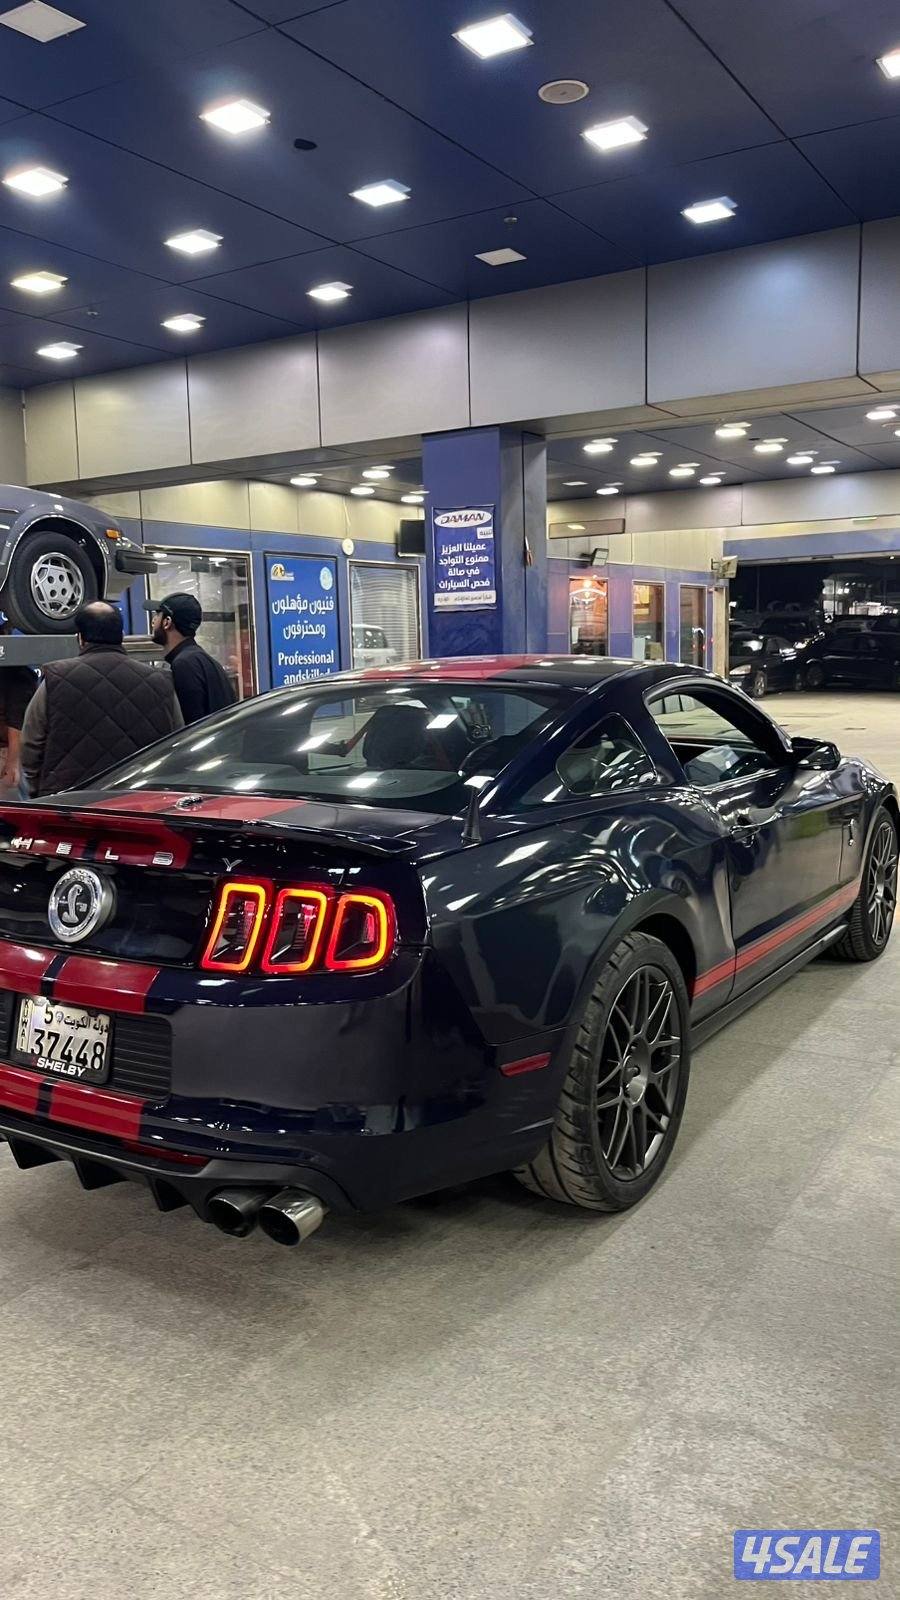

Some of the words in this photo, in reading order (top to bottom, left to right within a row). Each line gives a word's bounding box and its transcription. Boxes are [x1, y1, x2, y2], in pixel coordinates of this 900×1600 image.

[440, 513, 485, 524] DAMAN
[441, 543, 462, 555] العزيز
[463, 542, 486, 552] عميلنا
[439, 555, 464, 566] التواجد
[465, 555, 489, 565] ممنوع
[448, 567, 465, 576] صالة
[466, 567, 480, 577] في
[438, 578, 470, 590] السيارات
[470, 578, 490, 589] فحص
[272, 593, 308, 615] مؤهلون
[309, 596, 334, 615] فنيون
[283, 620, 326, 640] ومحترفون
[278, 649, 334, 666] Professional
[44, 1003, 54, 1025] 5
[64, 1015, 91, 1030] الكويت
[30, 1028, 105, 1071] 37448
[36, 1057, 86, 1077] SHELBY
